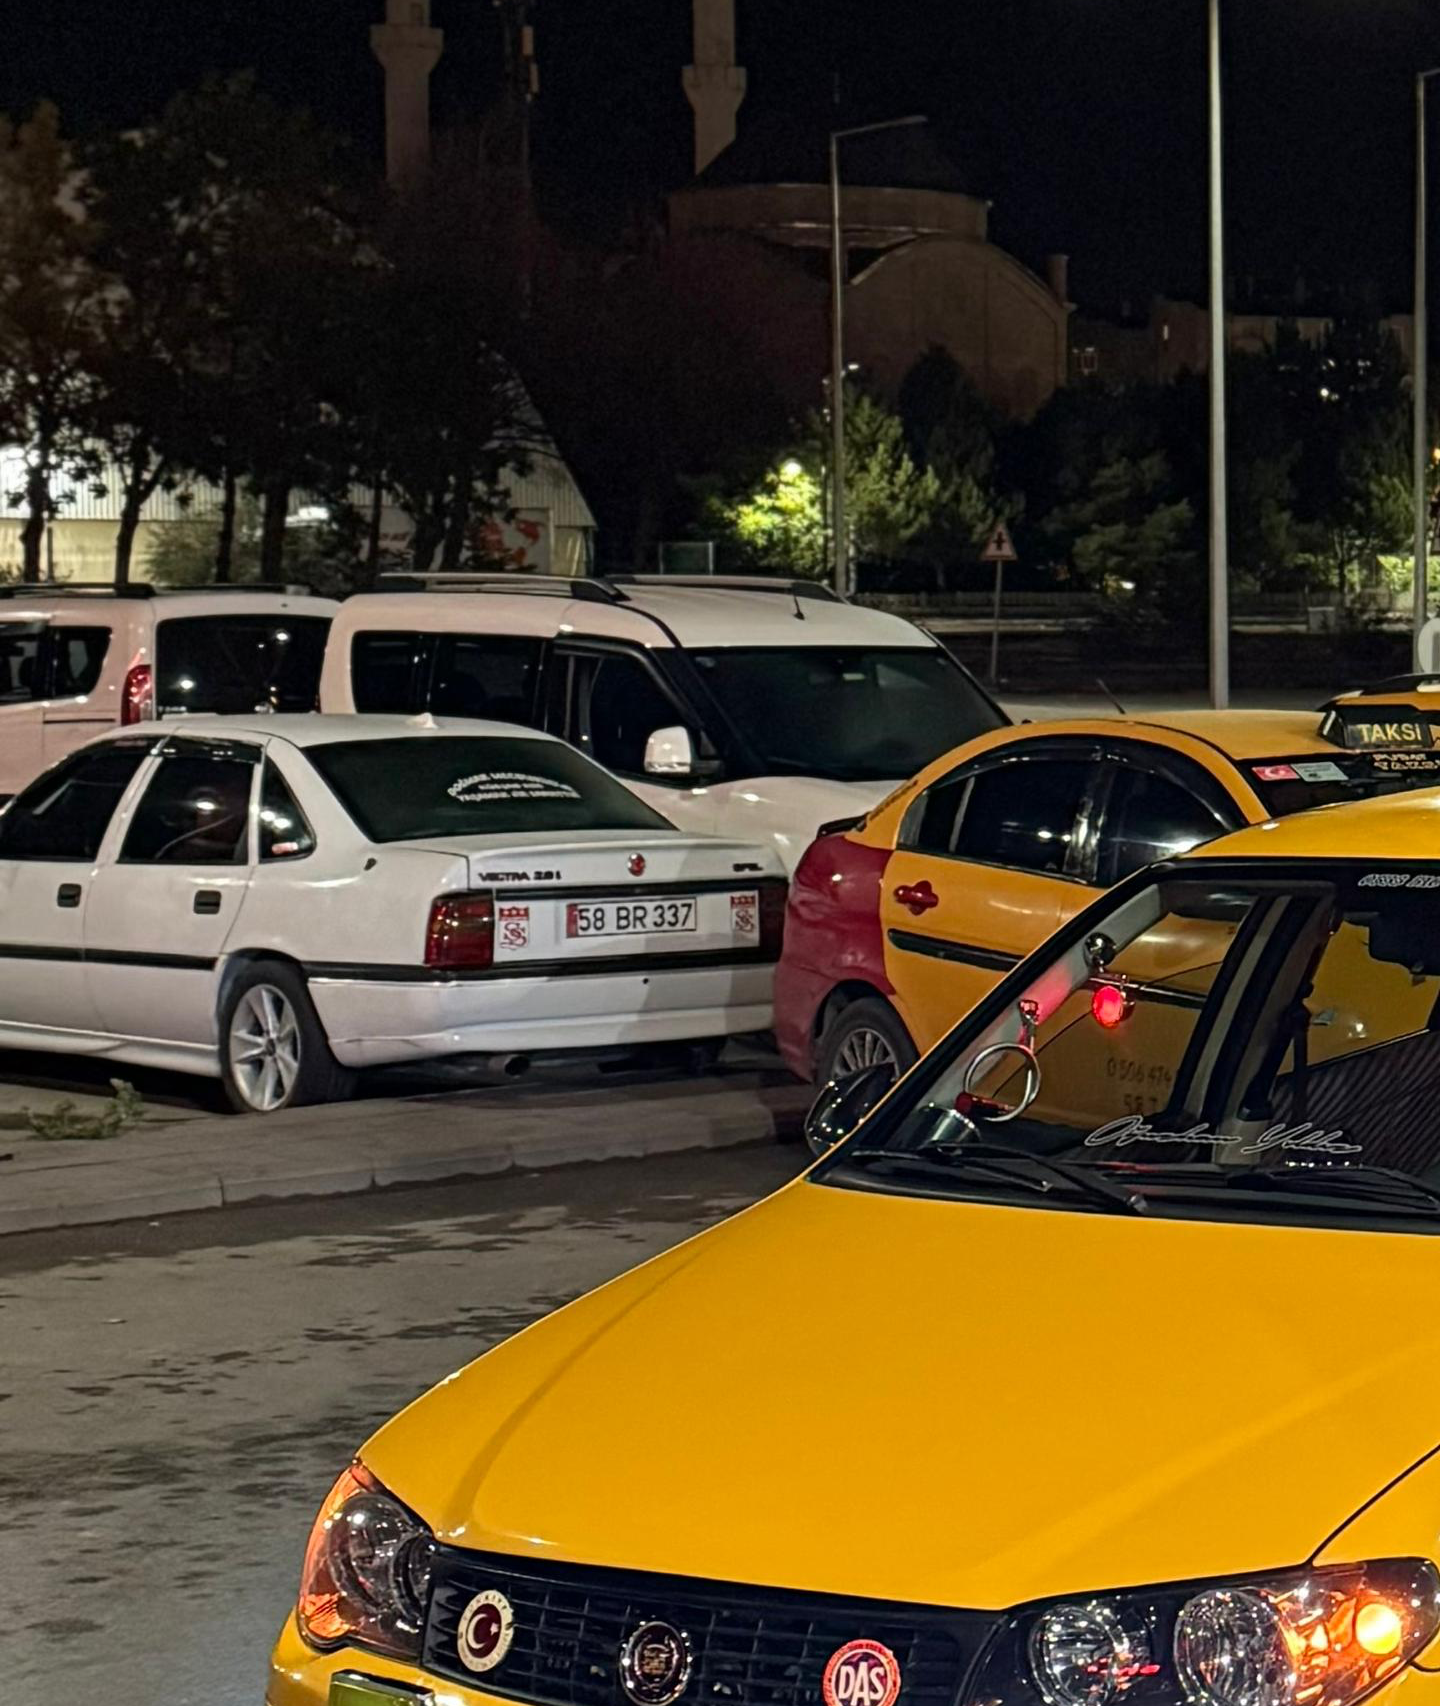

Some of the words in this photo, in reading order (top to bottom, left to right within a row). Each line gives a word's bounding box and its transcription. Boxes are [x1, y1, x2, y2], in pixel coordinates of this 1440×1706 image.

[577, 908, 606, 932] 58
[615, 905, 649, 931] BR
[653, 902, 693, 929] 337
